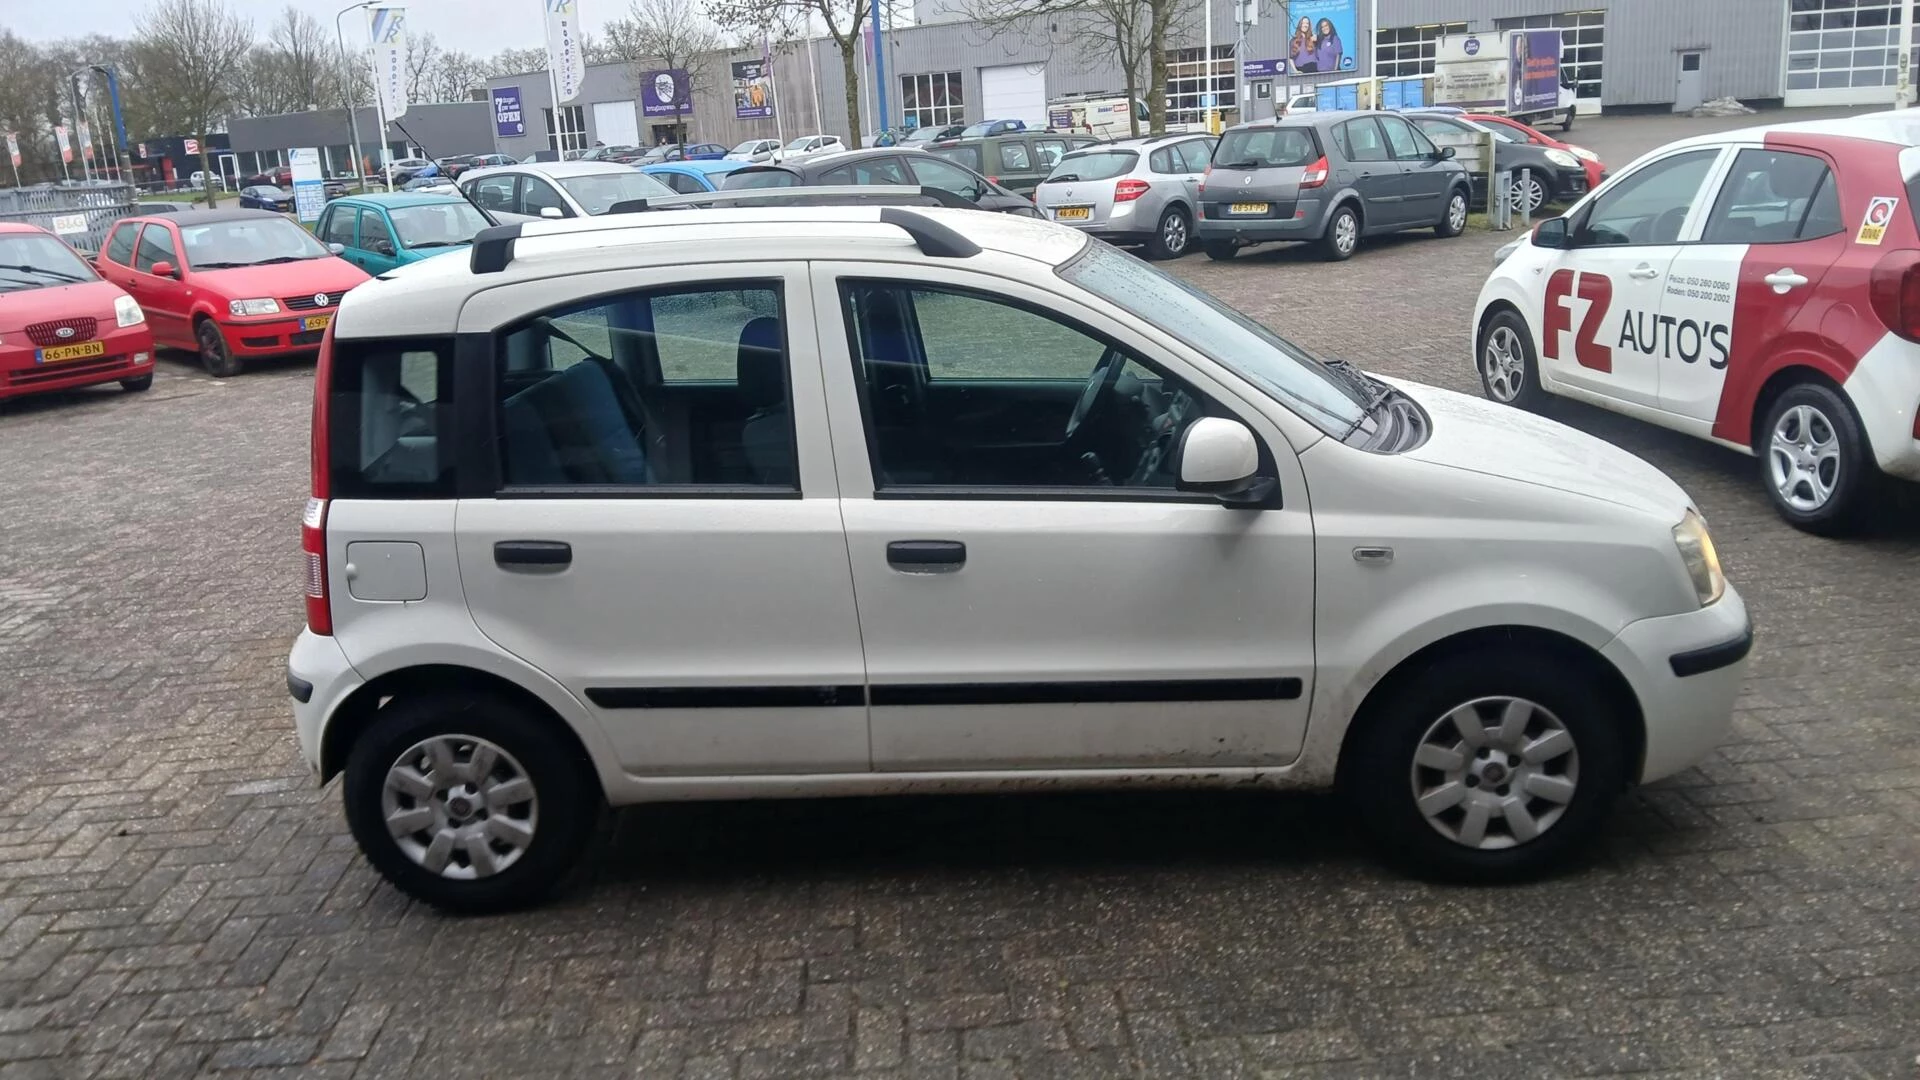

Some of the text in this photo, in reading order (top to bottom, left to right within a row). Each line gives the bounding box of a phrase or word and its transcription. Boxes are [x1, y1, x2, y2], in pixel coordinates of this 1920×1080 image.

[498, 111, 521, 123] OPEN
[1543, 268, 1613, 374] FZ
[1618, 309, 1730, 370] AUTO'S
[45, 343, 101, 360] 66-PN-BN
